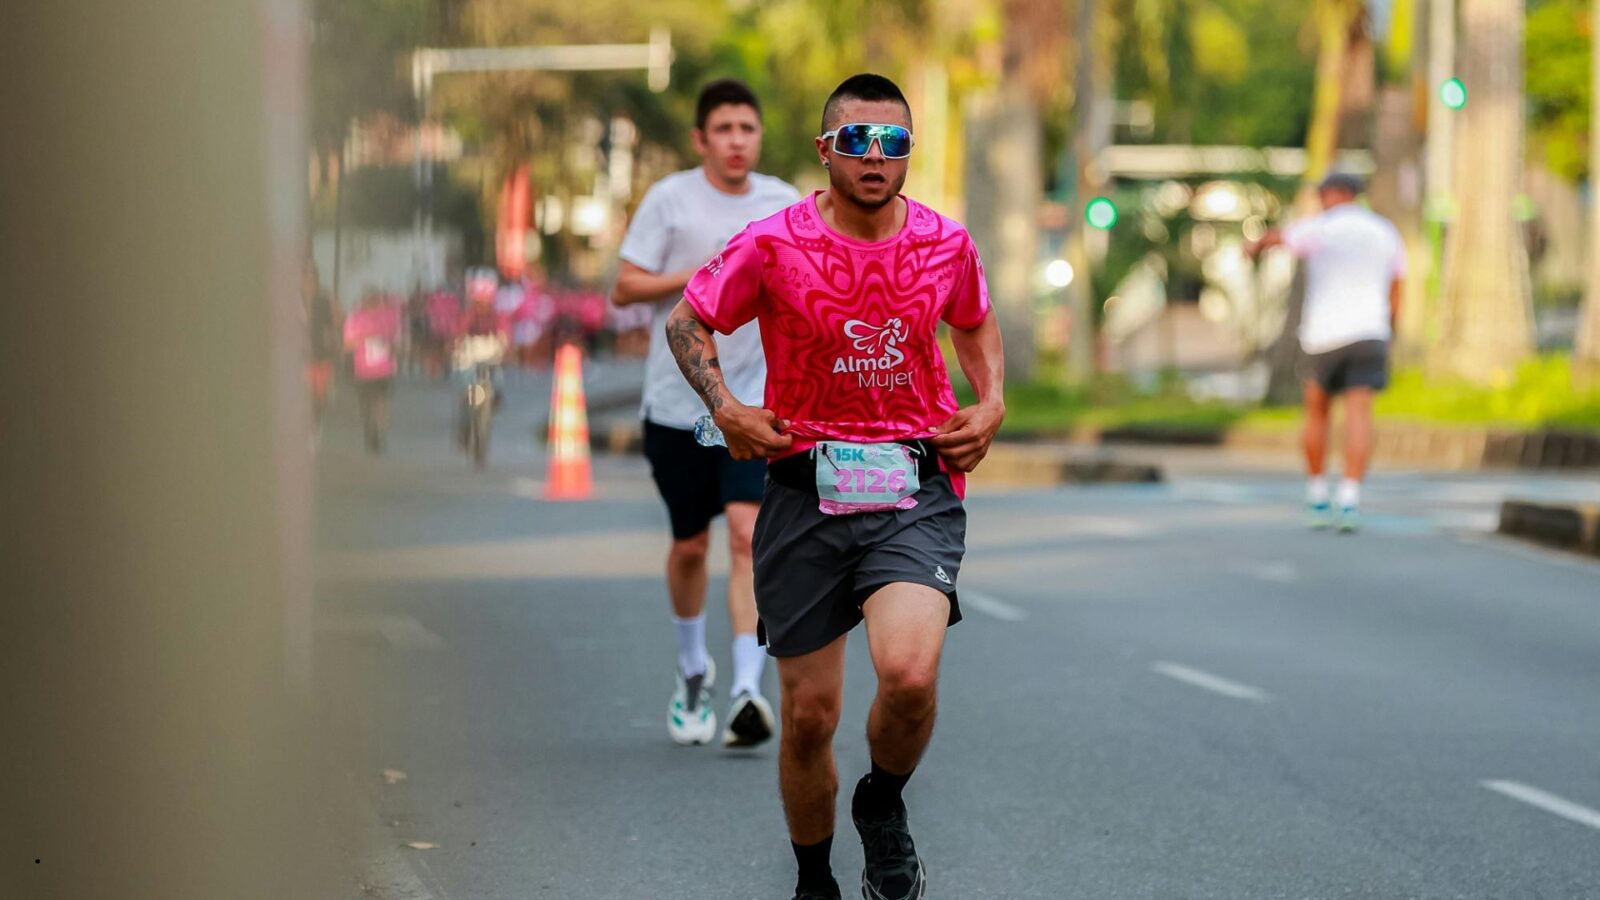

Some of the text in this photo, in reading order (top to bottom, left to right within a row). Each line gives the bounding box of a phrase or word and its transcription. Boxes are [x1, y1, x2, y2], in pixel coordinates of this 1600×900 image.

[832, 355, 891, 374] Alma
[858, 369, 914, 392] Mujer
[833, 448, 865, 462] 15K
[832, 468, 907, 493] 2126
